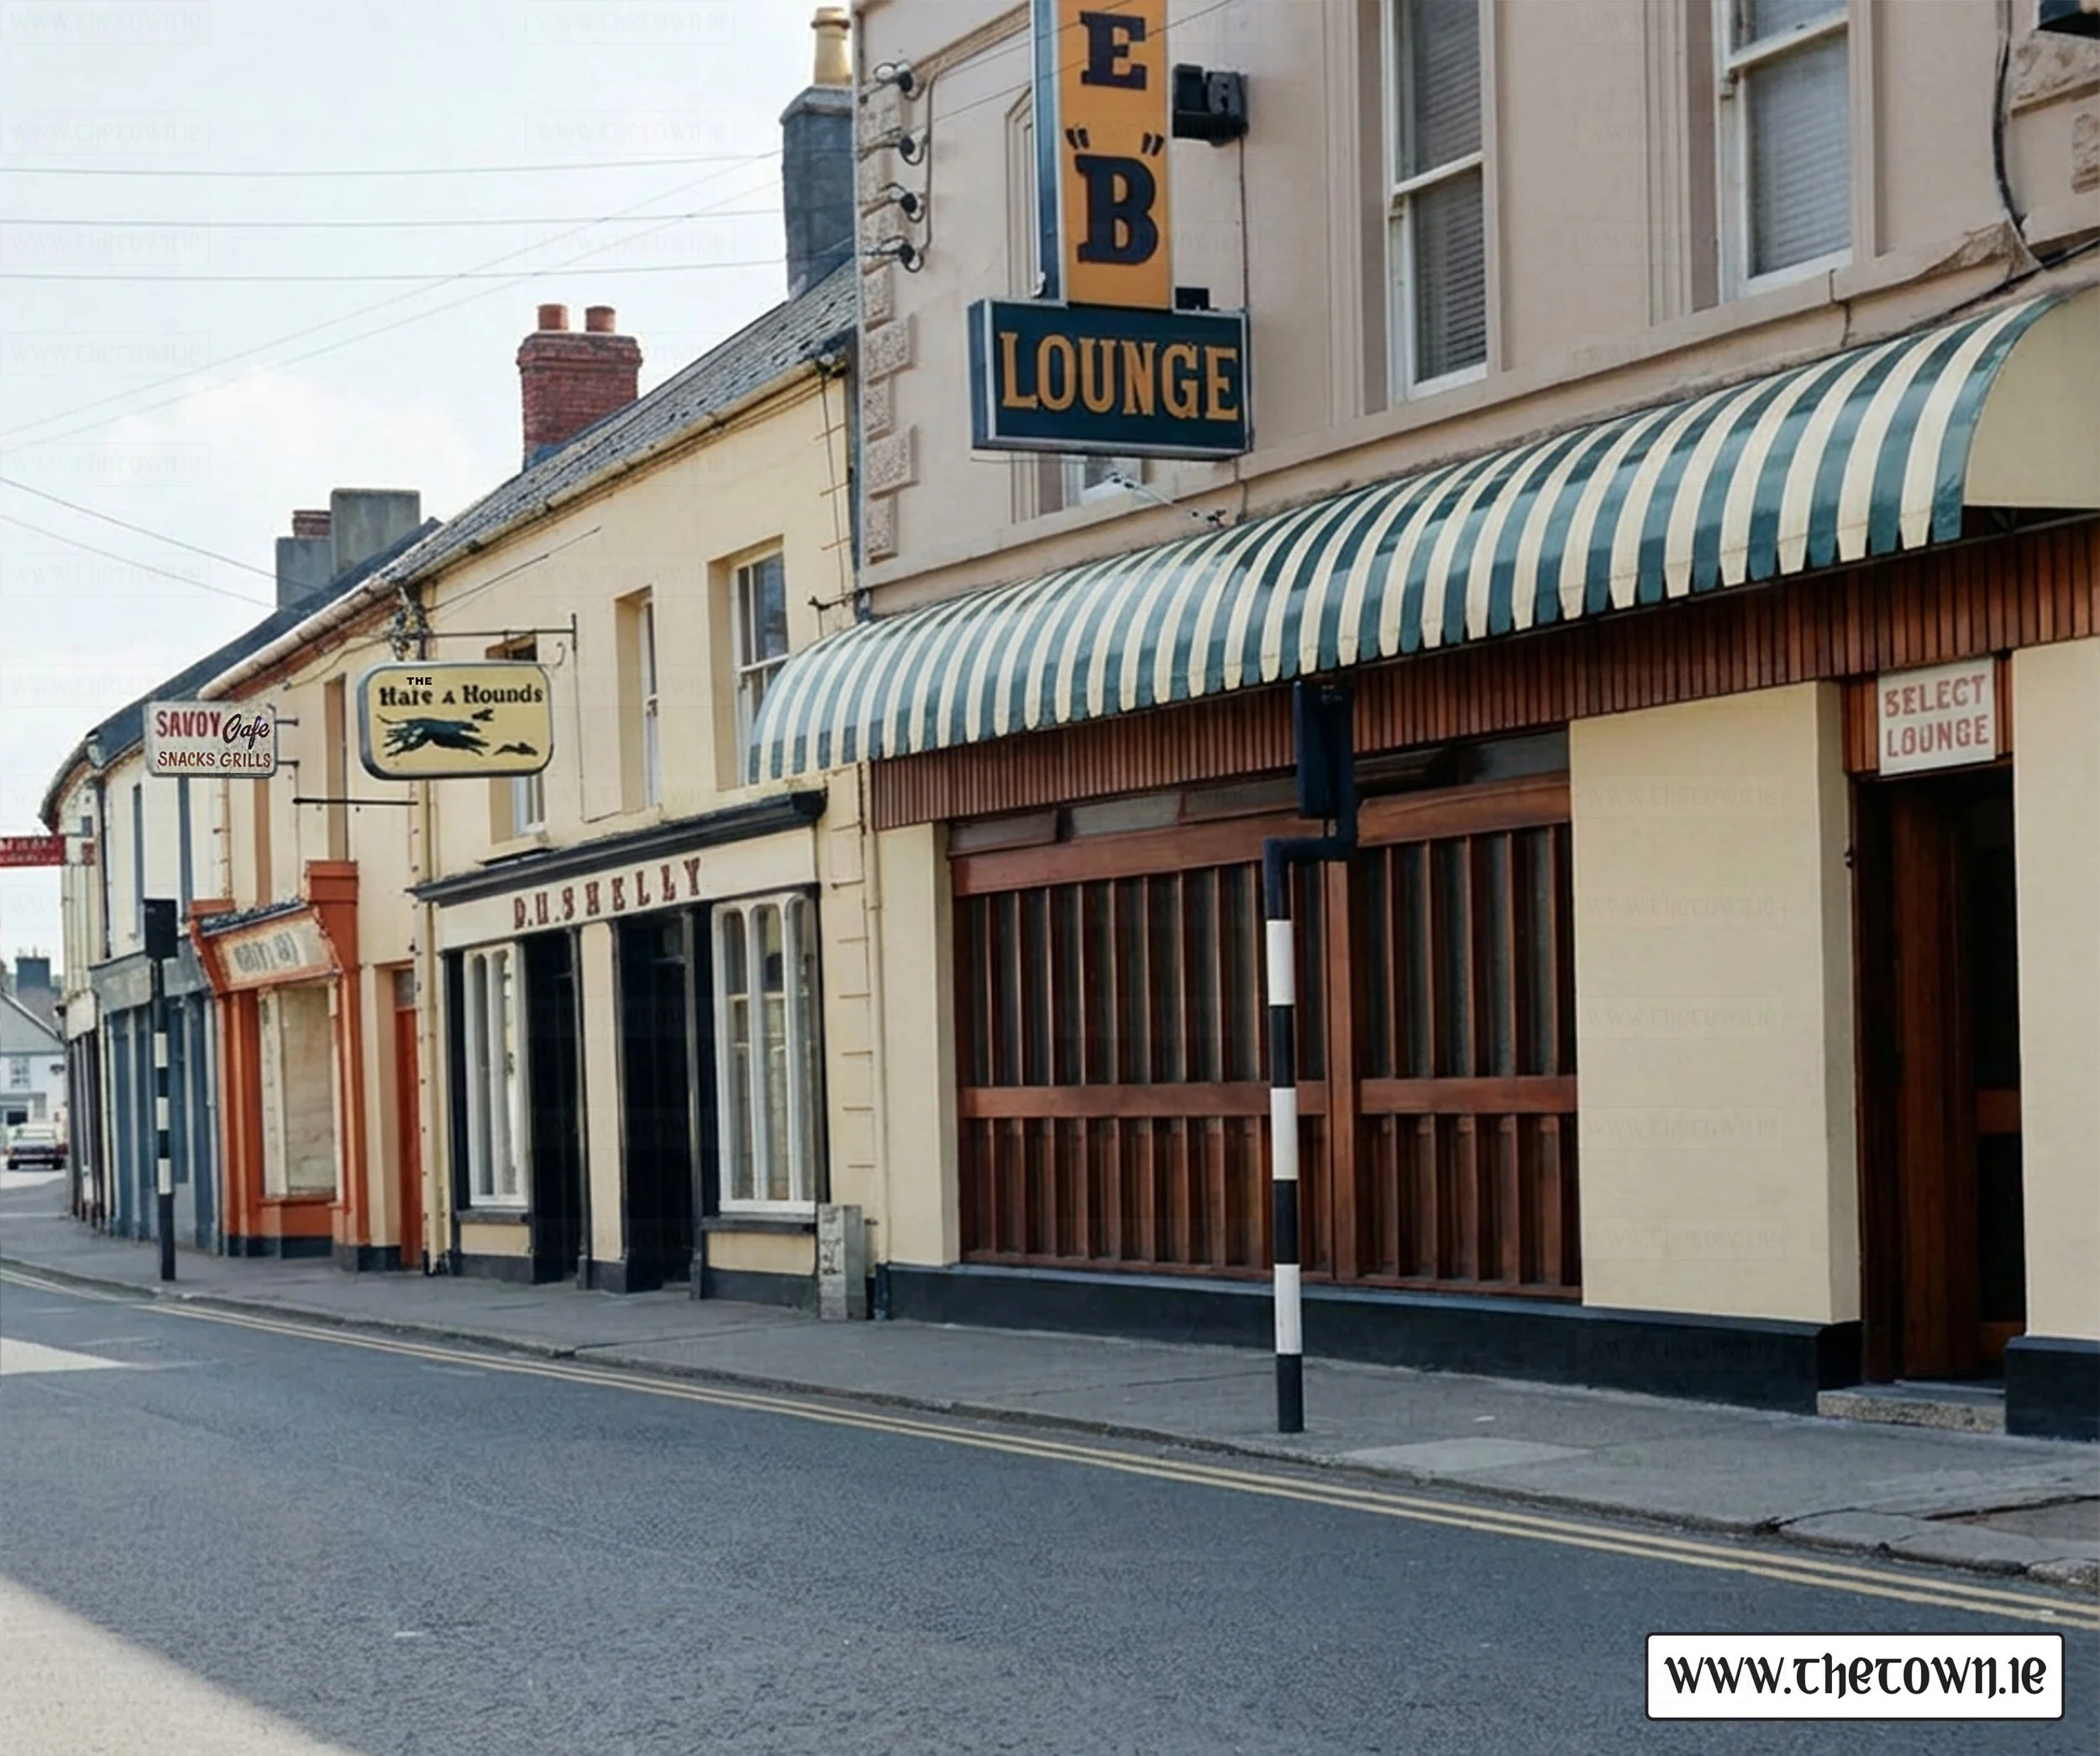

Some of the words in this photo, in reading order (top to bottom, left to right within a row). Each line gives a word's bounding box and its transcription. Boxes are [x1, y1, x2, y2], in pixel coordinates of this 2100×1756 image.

[1080, 11, 1147, 91] E
[999, 331, 1239, 421] LOUNGE
[407, 676, 433, 686] THE
[461, 684, 543, 705] Hounds
[1884, 674, 1986, 718] SELECT
[156, 710, 222, 738] SAVOY
[222, 713, 270, 750] Cafe
[1887, 714, 1990, 758] LOUNGE
[157, 750, 215, 767] SNACKS
[219, 752, 271, 768] GRILLS
